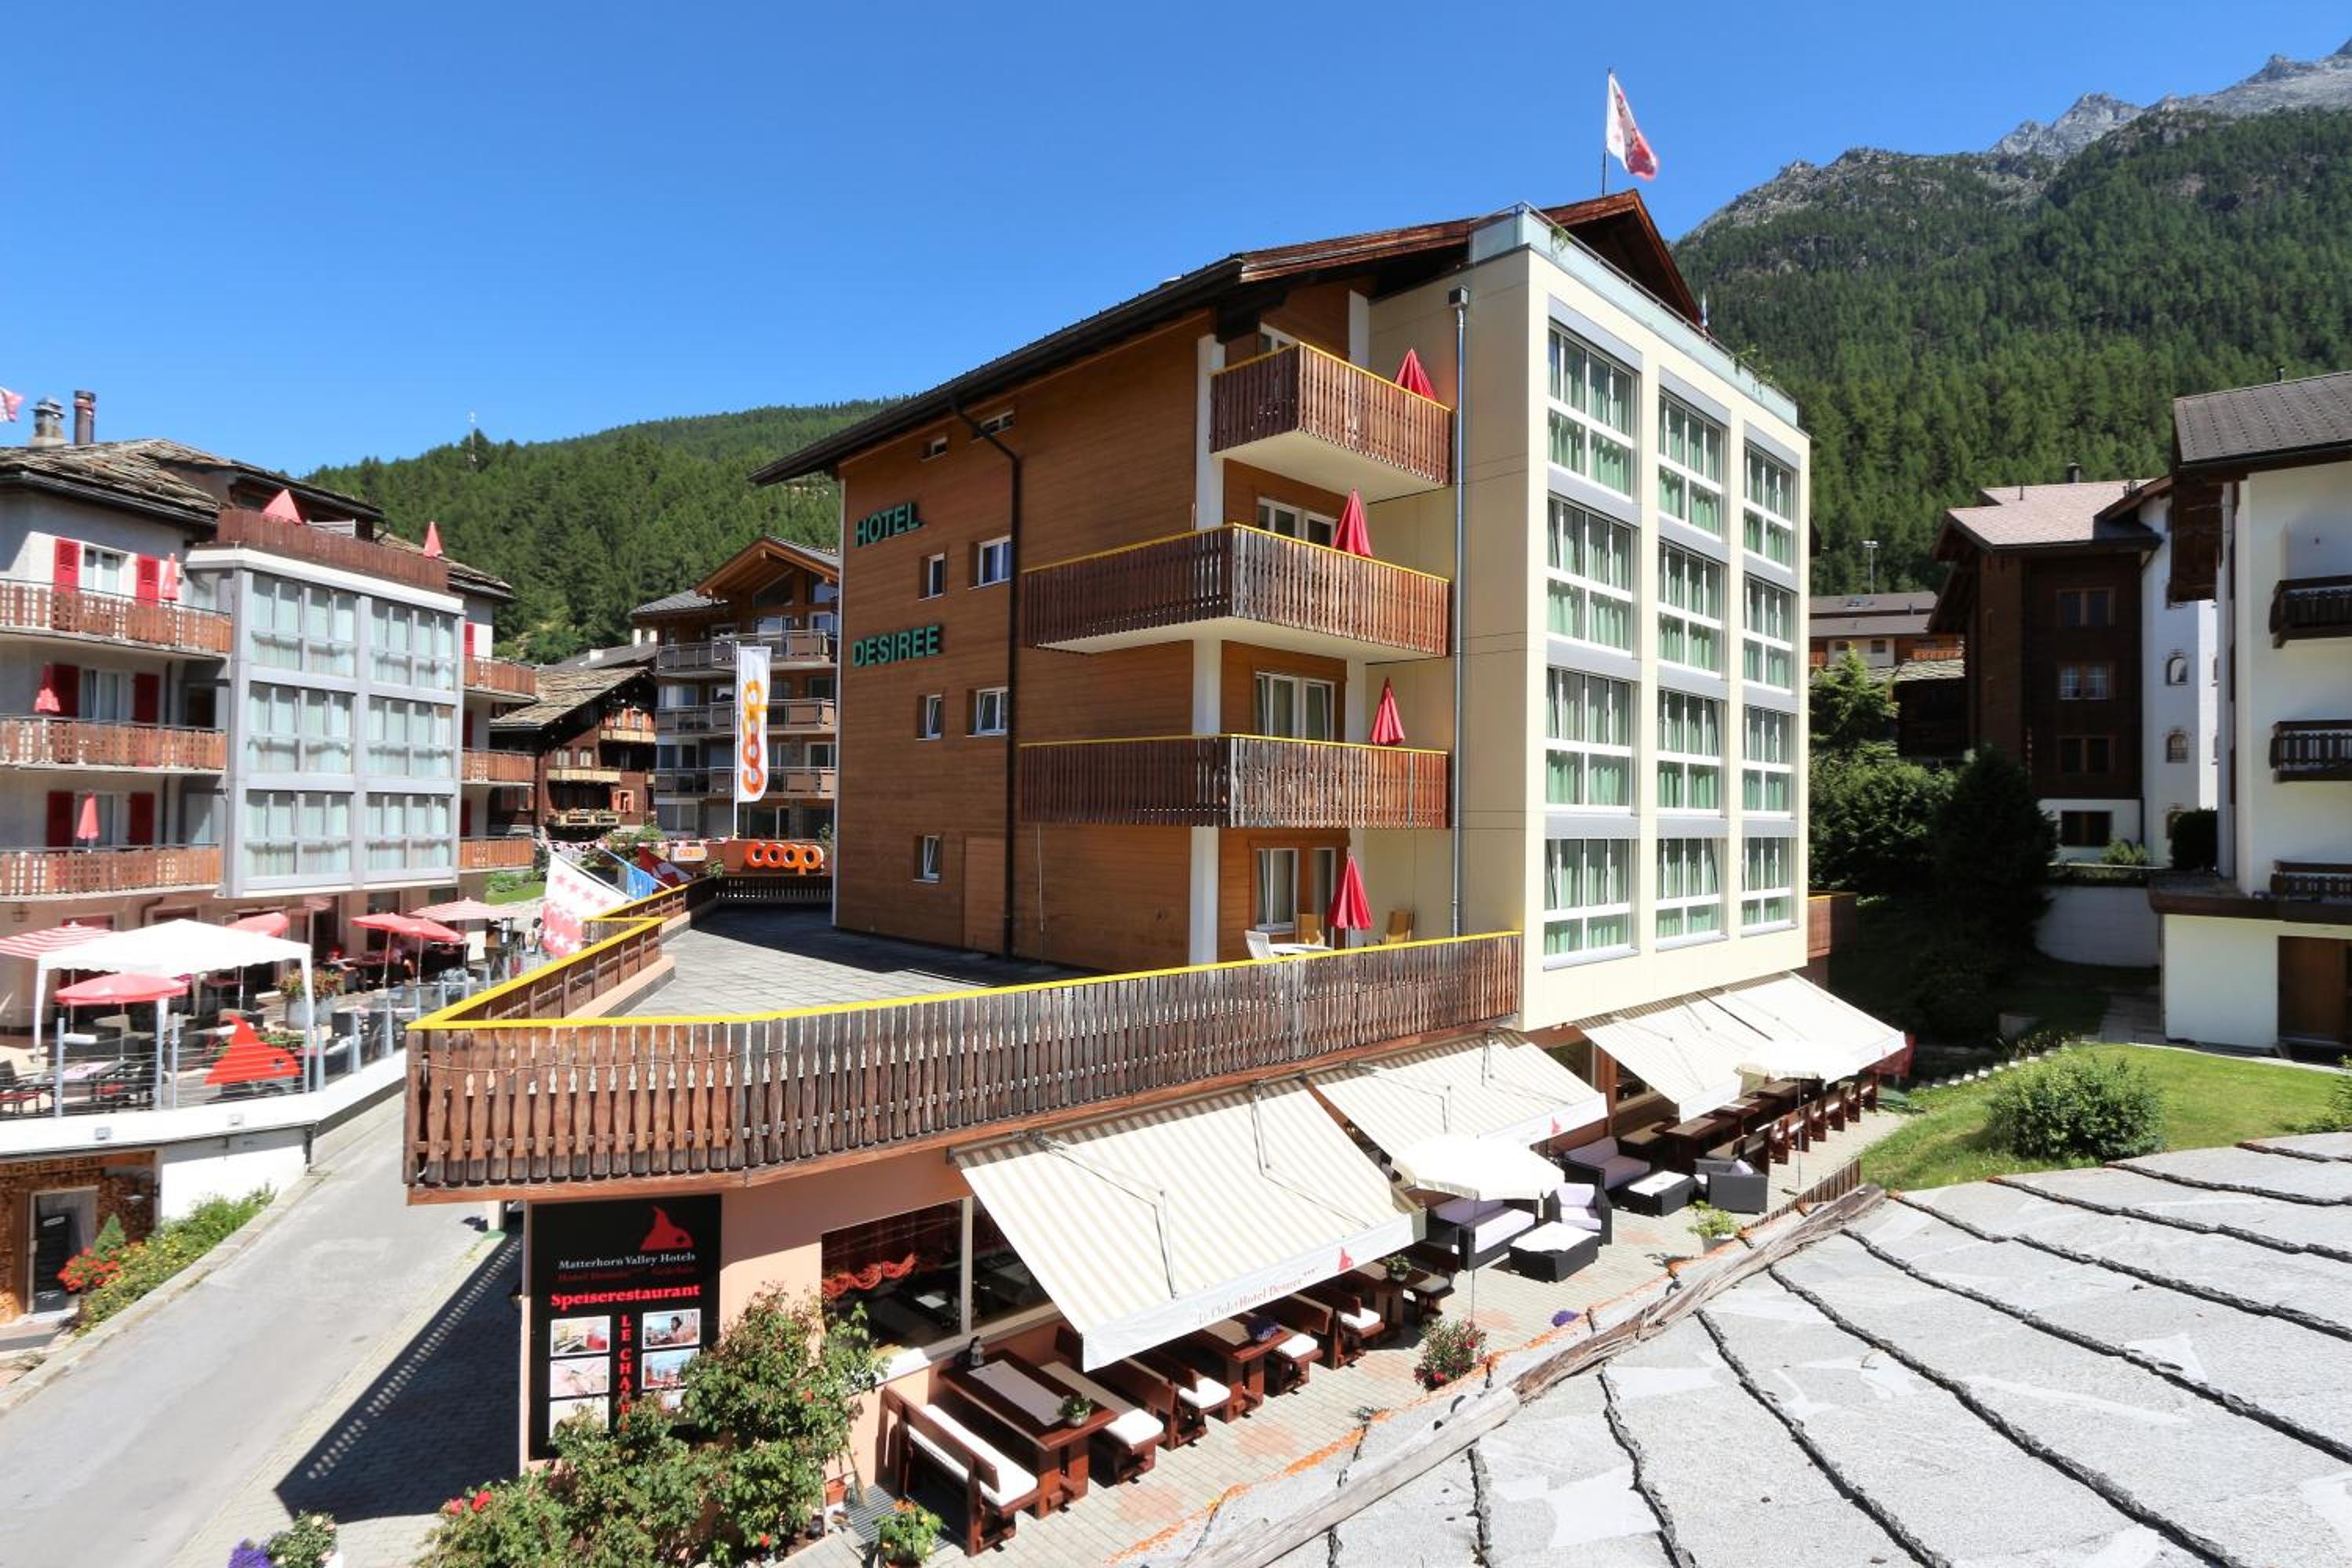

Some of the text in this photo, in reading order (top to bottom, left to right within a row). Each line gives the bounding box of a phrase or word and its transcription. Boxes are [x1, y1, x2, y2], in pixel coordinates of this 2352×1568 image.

[855, 503, 920, 547] HOTEL
[852, 626, 940, 666] DESIREE
[742, 679, 768, 794] coop
[746, 843, 824, 876] coop
[558, 1252, 696, 1269] Matterhorn Valley Hotels
[550, 1284, 701, 1311] Speiserestaurant
